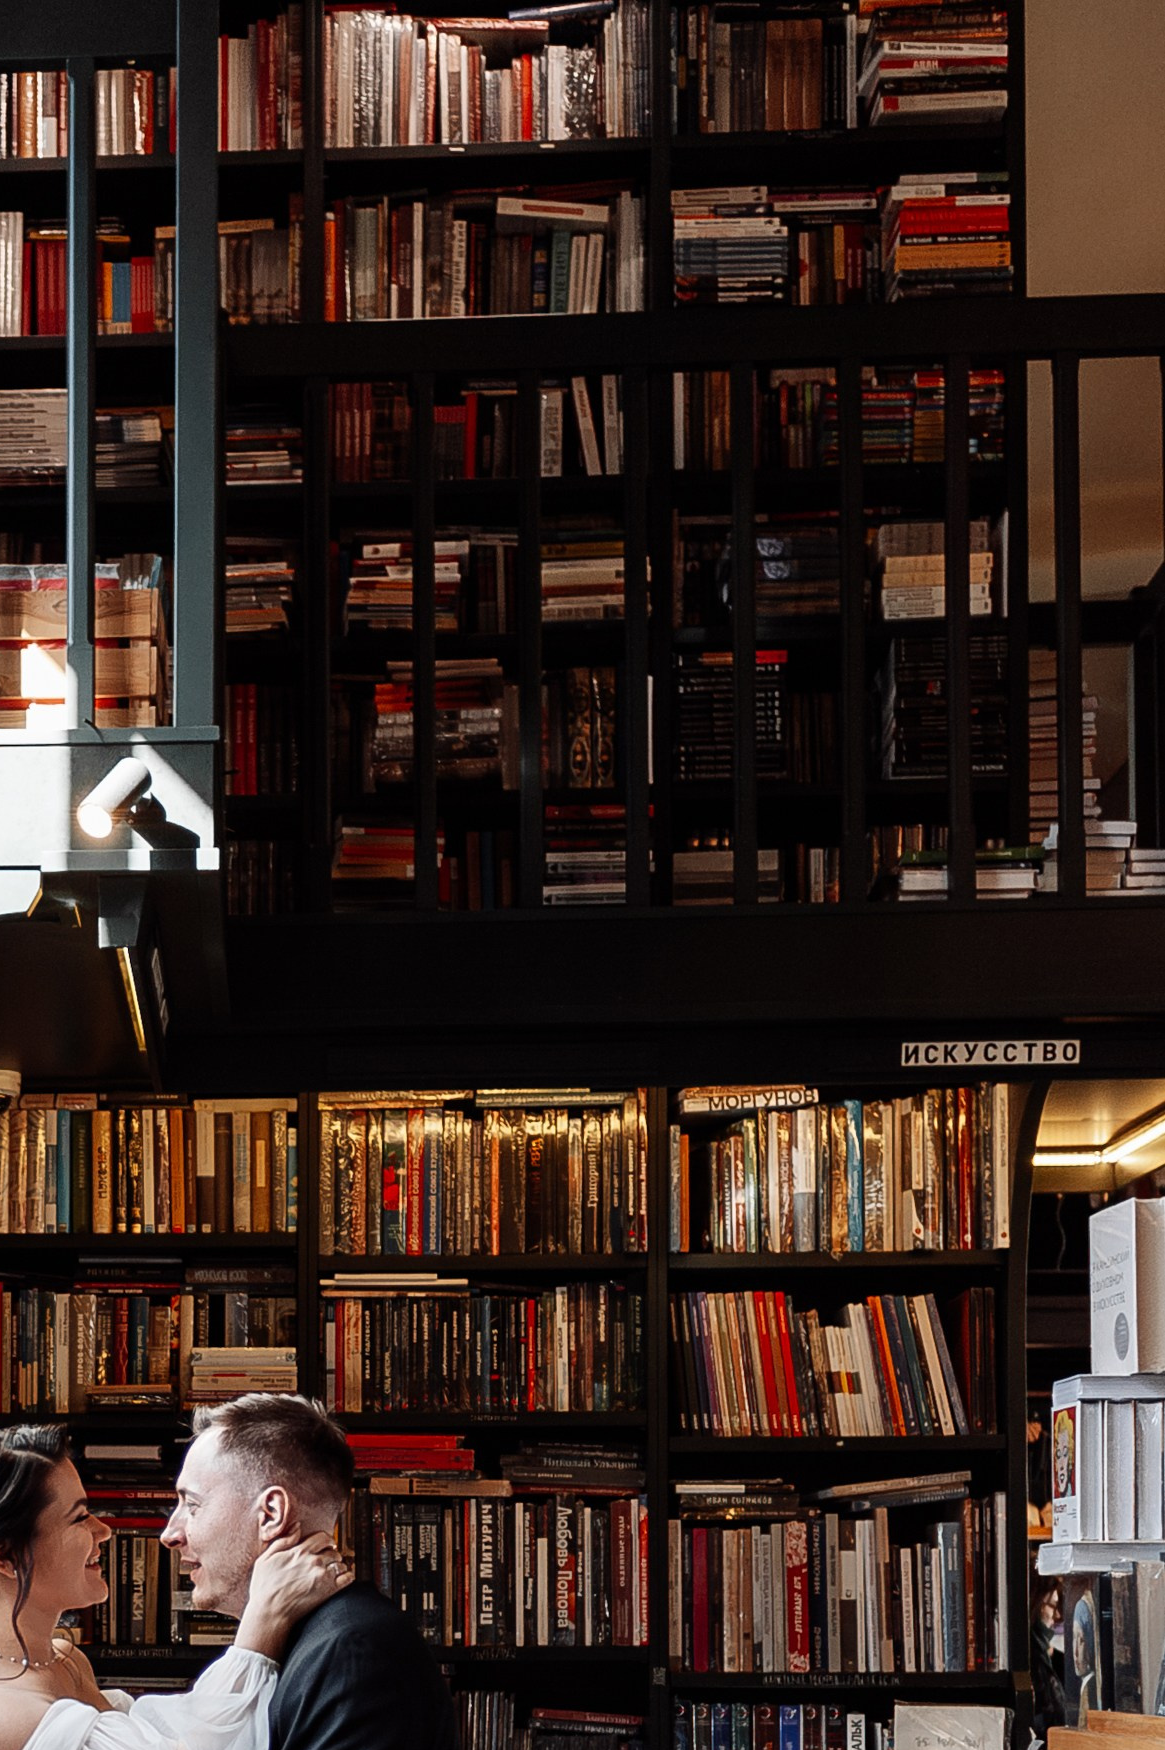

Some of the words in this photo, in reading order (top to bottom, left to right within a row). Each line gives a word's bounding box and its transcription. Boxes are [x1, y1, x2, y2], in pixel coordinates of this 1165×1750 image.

[903, 1043, 1078, 1064] ИСКУССТВО
[709, 1089, 815, 1111] МОРГУНОВ
[479, 1503, 494, 1579] МИТУРИЧ
[556, 1506, 573, 1567] Любовь
[556, 1570, 572, 1629] Попова
